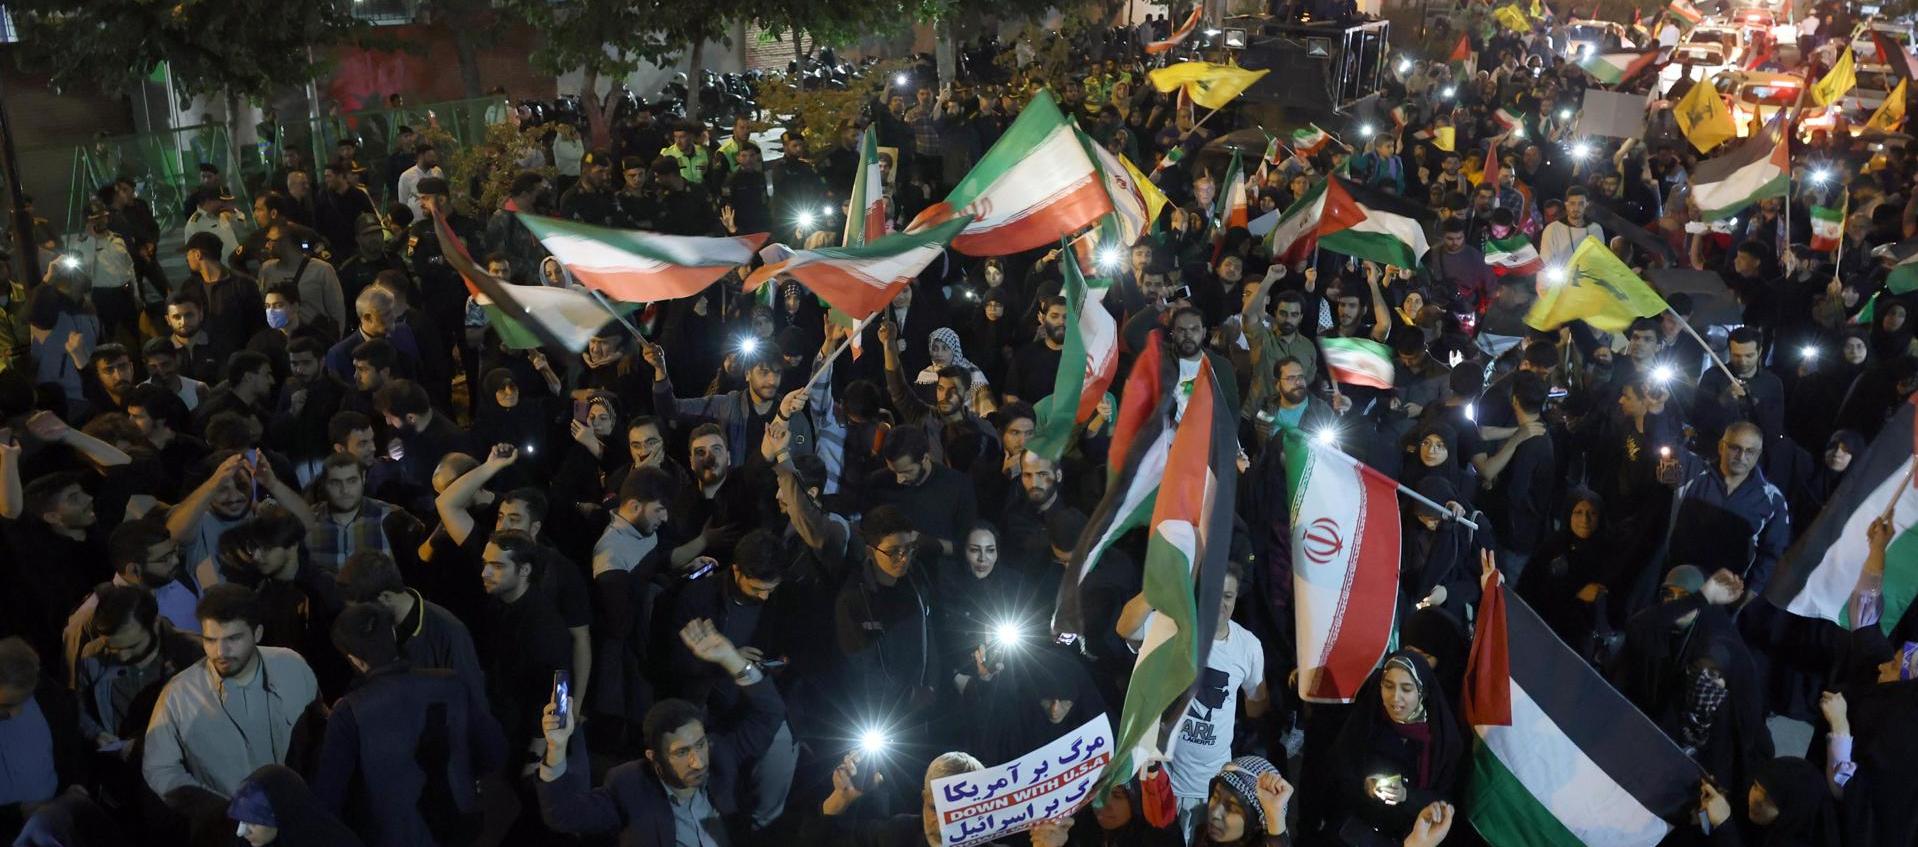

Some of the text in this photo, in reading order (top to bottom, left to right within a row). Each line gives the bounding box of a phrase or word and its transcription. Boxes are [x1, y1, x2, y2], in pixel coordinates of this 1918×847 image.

[1180, 718, 1217, 741] ARL
[943, 735, 1105, 803] مرگ بر آمریکا
[949, 796, 1009, 822] DOWN
[1012, 777, 1060, 803] WITH
[1062, 756, 1105, 783] U.S.A
[949, 802, 1034, 843] اسرائیل
[1044, 798, 1060, 818] بر
